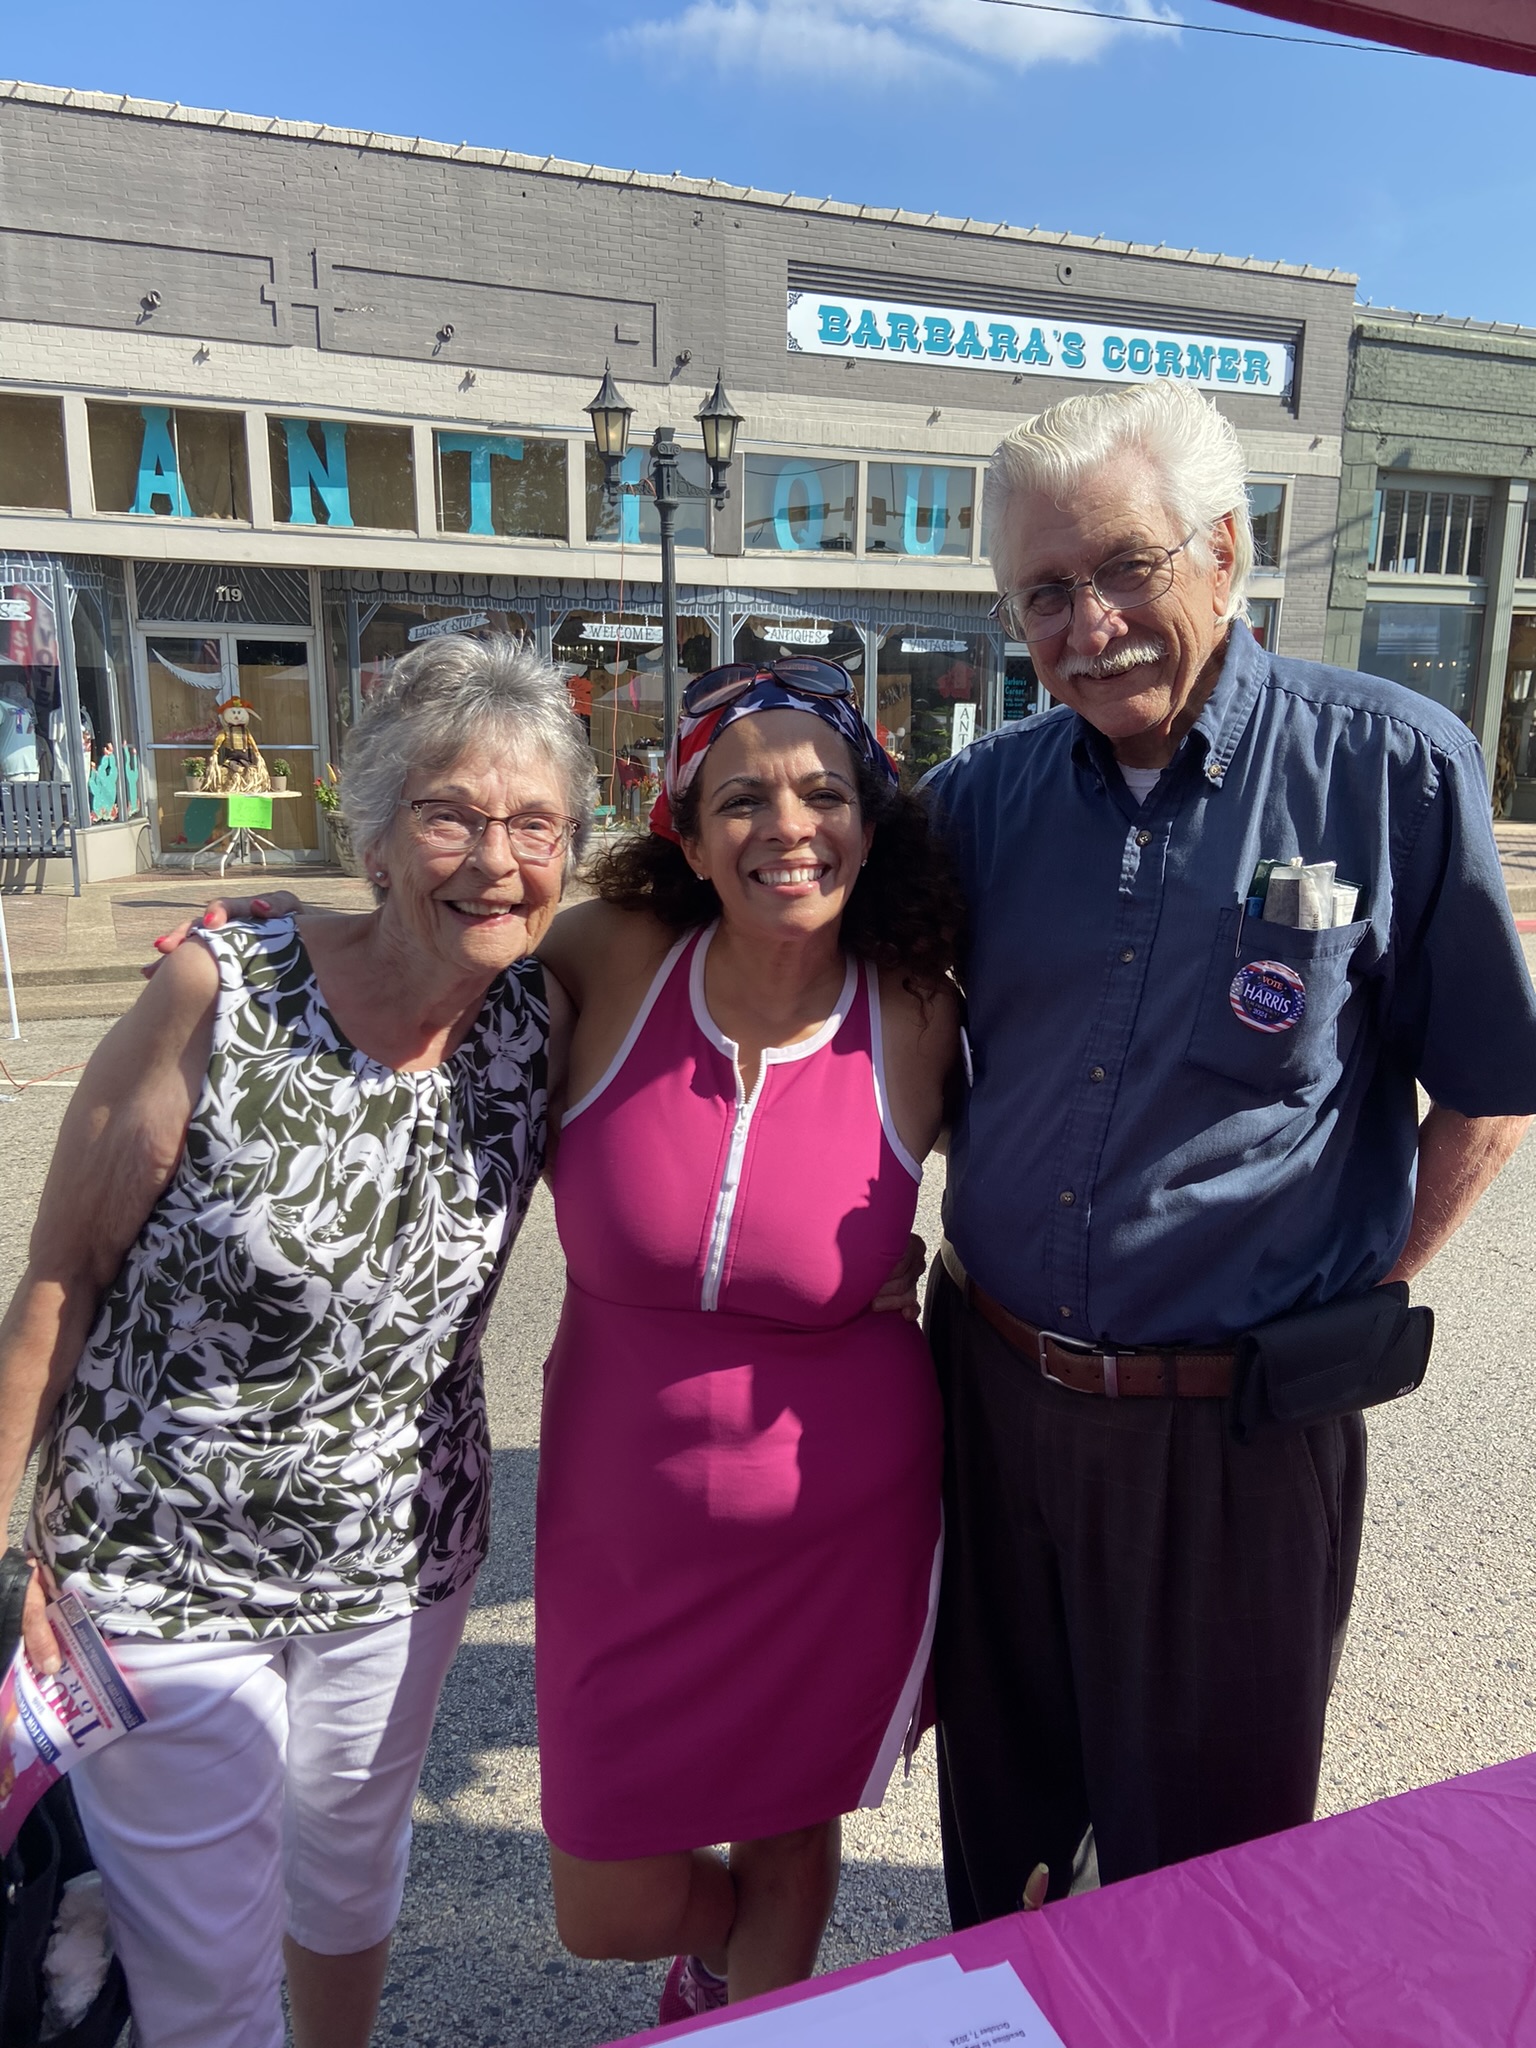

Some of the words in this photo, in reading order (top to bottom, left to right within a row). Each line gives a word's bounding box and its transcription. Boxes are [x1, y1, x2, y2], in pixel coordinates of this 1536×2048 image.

[816, 304, 1087, 369] BARBARA'S
[1102, 336, 1273, 385] CORNER
[216, 585, 243, 602] 119
[414, 622, 440, 639] LOTS
[451, 613, 483, 631] STUFF
[590, 624, 655, 641] WELCOME
[770, 628, 824, 644] ANTIQUES
[908, 638, 956, 651] VINTAGE
[1262, 975, 1284, 990] VOTE
[1243, 983, 1292, 1013] HARRIS
[34, 1733, 56, 1761] VOTE
